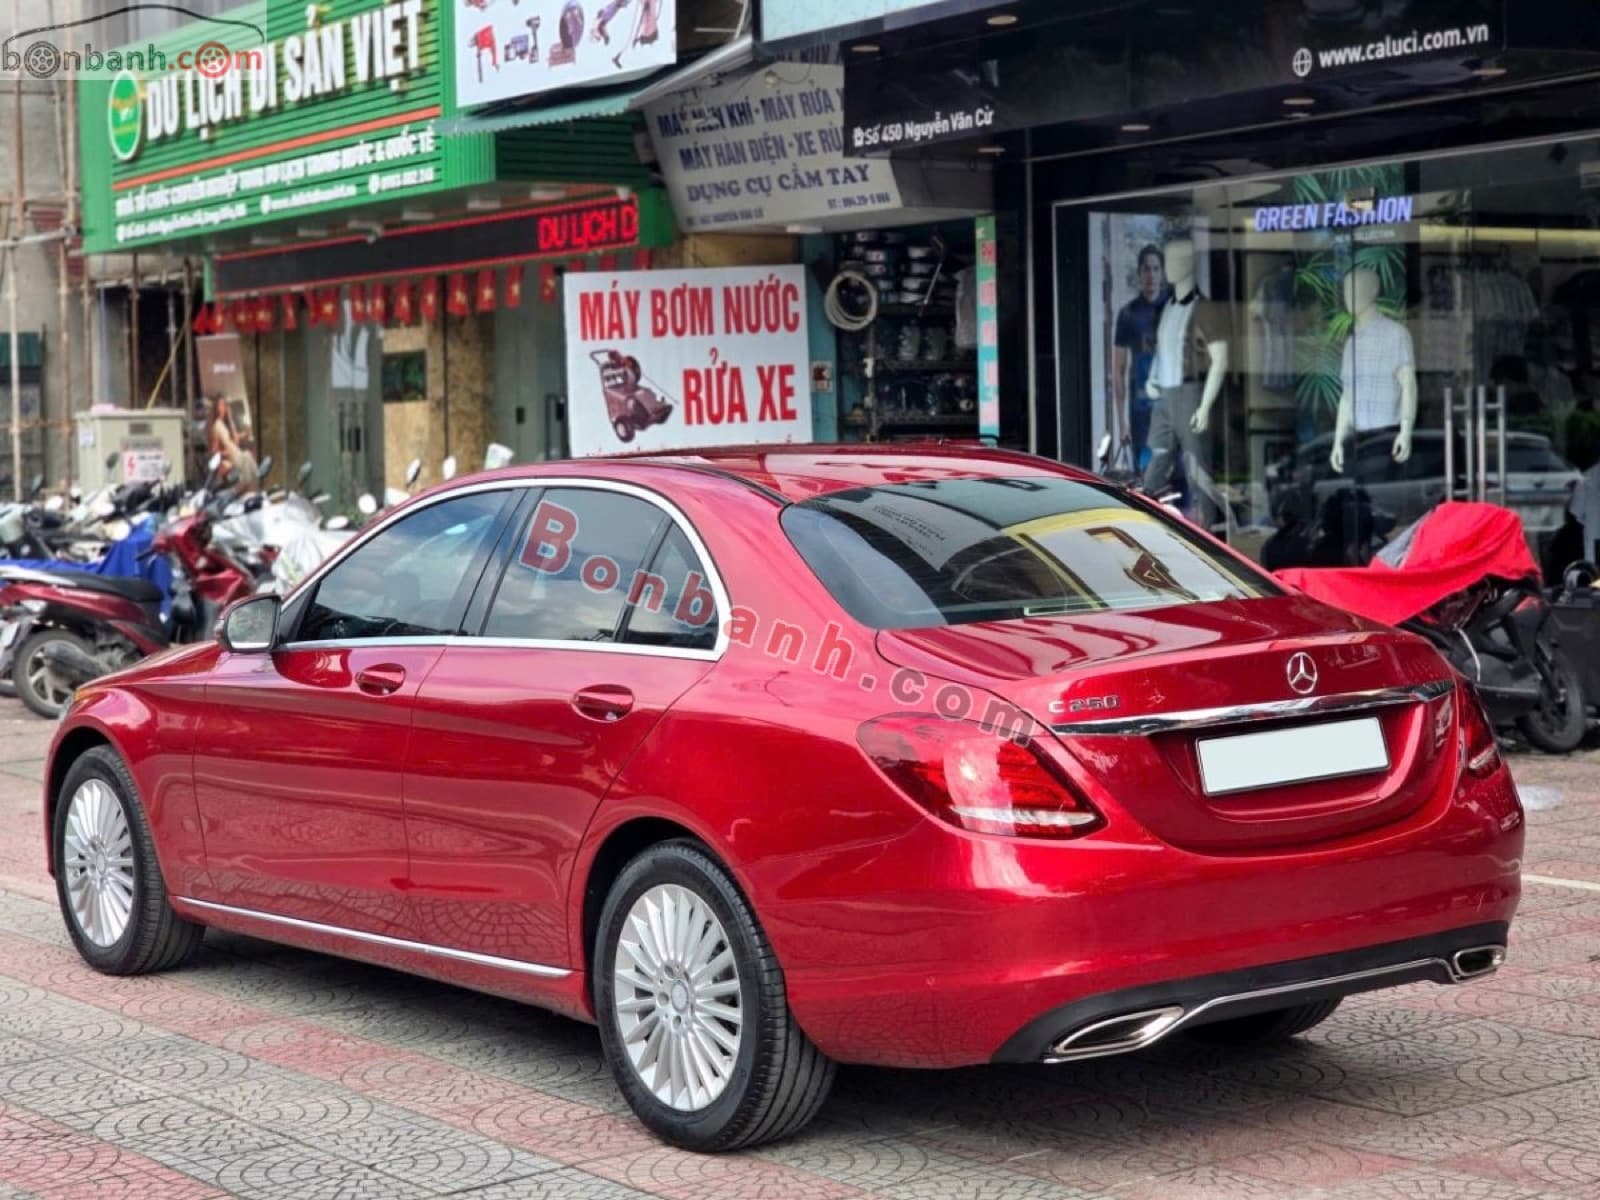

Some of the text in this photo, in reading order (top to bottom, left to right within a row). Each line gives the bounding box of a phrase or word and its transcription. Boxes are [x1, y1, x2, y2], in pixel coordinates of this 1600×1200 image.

[1318, 24, 1489, 68] www.caluci.com.vn
[146, 74, 179, 140] DU
[185, 60, 243, 140] LỊCH
[249, 42, 278, 112] DI
[283, 5, 346, 101] SẢN
[725, 95, 754, 128] KHÍ
[760, 90, 798, 123] MÁY
[798, 79, 836, 117] RỬA
[679, 137, 713, 171] MÁY
[713, 136, 748, 167] HÀN
[793, 129, 818, 157] XE
[818, 121, 844, 152] RÙ
[881, 122, 903, 142] 450
[905, 111, 950, 142] Nguyễn
[686, 180, 742, 204] DỤNG
[745, 175, 773, 197] CỤ
[826, 163, 870, 187] TAY
[538, 214, 568, 250] DU
[1254, 203, 1320, 233] GREEN
[579, 273, 800, 342] MÁY BƠM NƯỚC
[682, 347, 798, 426] RỬA XE
[1048, 694, 1119, 713] C 250
